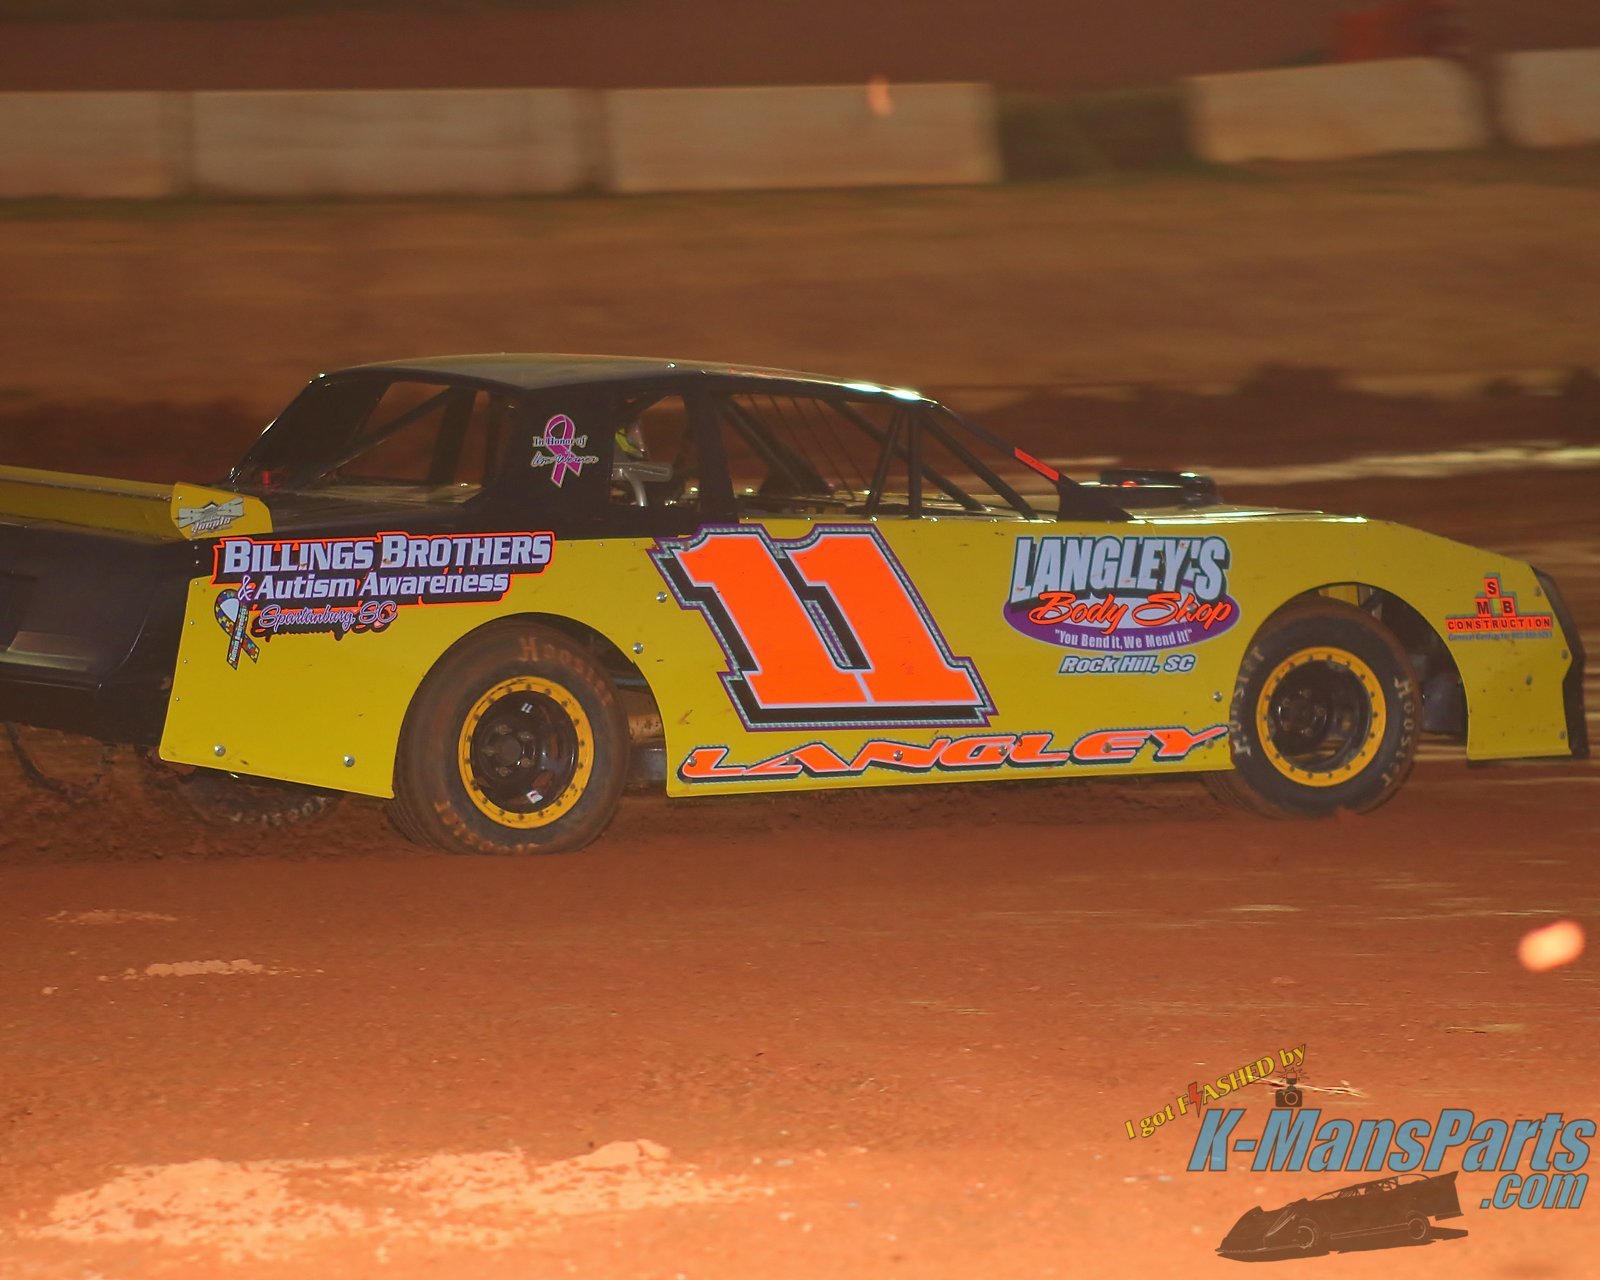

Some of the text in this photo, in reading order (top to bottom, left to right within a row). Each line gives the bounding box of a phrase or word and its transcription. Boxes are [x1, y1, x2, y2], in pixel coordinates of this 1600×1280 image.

[546, 436, 575, 446] Honor
[223, 535, 551, 573] BILLINGS BROTHERS
[1010, 536, 1227, 604] LANGLEY'S
[238, 572, 510, 601] & Autism Awareness
[359, 601, 399, 625] SC
[668, 530, 988, 712] 11
[1028, 591, 1232, 635] Body Shop
[1447, 618, 1551, 630] CONSTRUCTION
[1055, 629, 1079, 645] "You
[1081, 633, 1110, 649] Bend
[1124, 636, 1143, 649] We
[1145, 631, 1177, 648] Mend
[1060, 654, 1196, 674] Rock Hill, SC
[679, 726, 1229, 779] LANGLEY
